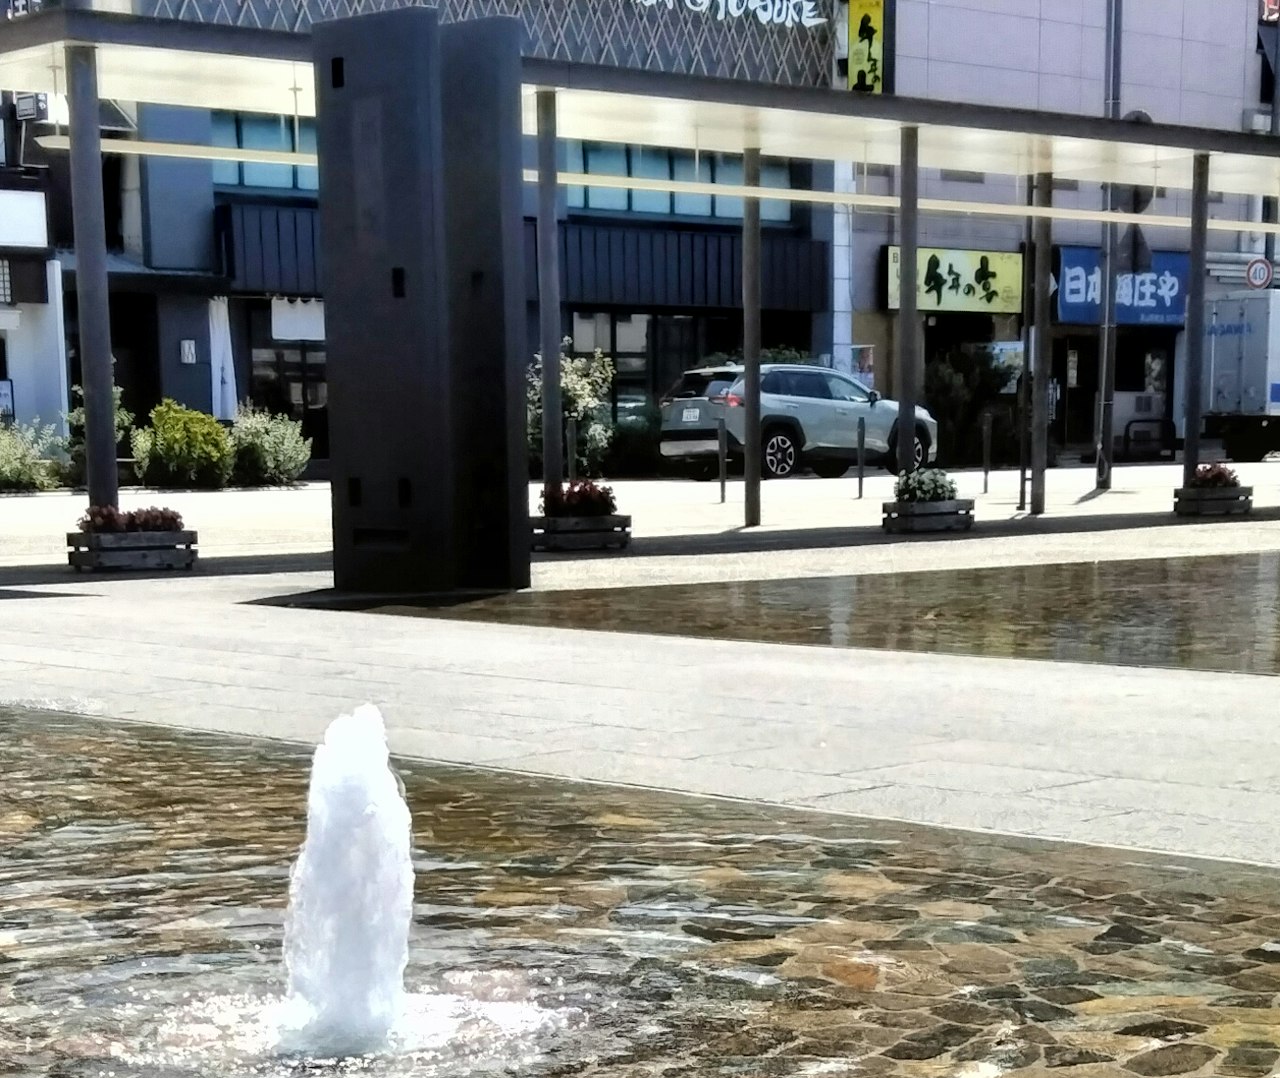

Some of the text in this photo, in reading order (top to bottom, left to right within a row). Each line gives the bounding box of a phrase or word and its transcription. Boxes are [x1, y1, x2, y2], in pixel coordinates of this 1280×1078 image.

[924, 254, 999, 306] 千年の宴
[1252, 266, 1266, 281] 40
